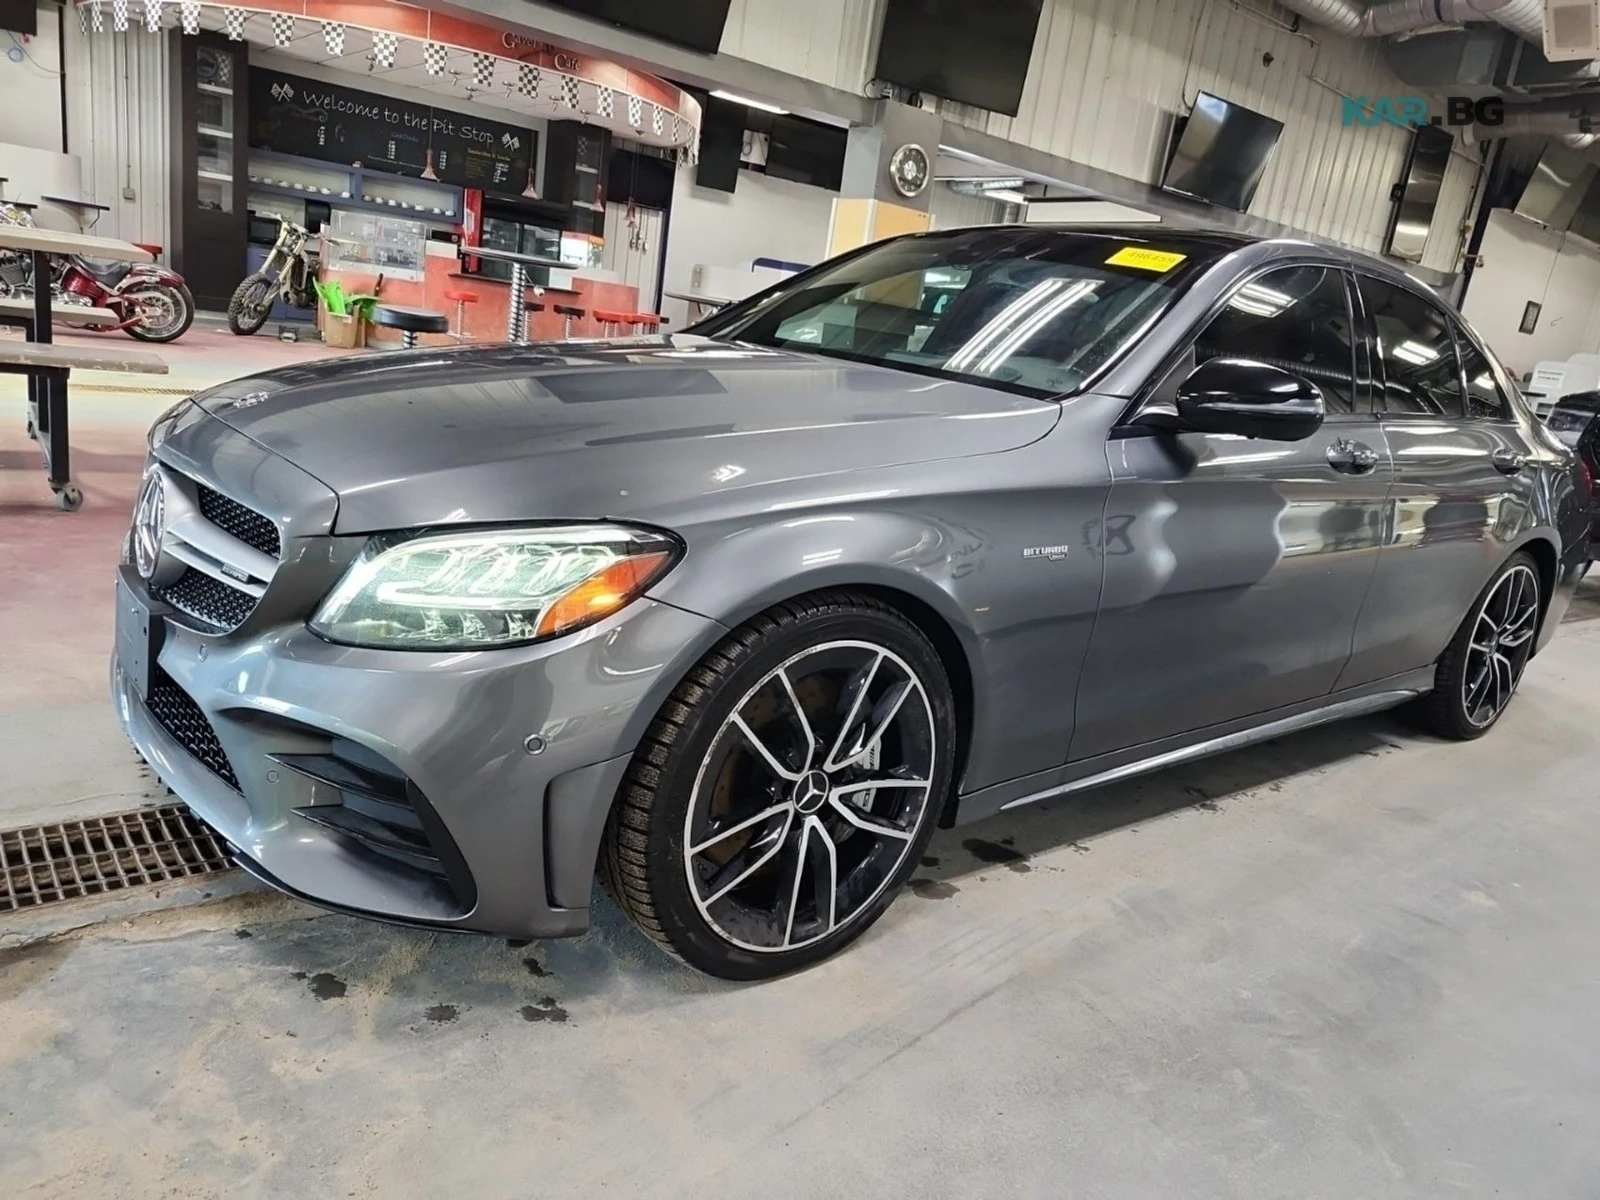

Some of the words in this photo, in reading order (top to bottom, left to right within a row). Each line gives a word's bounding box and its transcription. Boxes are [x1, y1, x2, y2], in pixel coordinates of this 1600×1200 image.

[303, 91, 379, 119] Welcome
[384, 107, 399, 124] to
[404, 112, 427, 130] the
[433, 119, 455, 135] Pit
[459, 126, 494, 148] Stop
[1023, 545, 1068, 556] BITURBO
